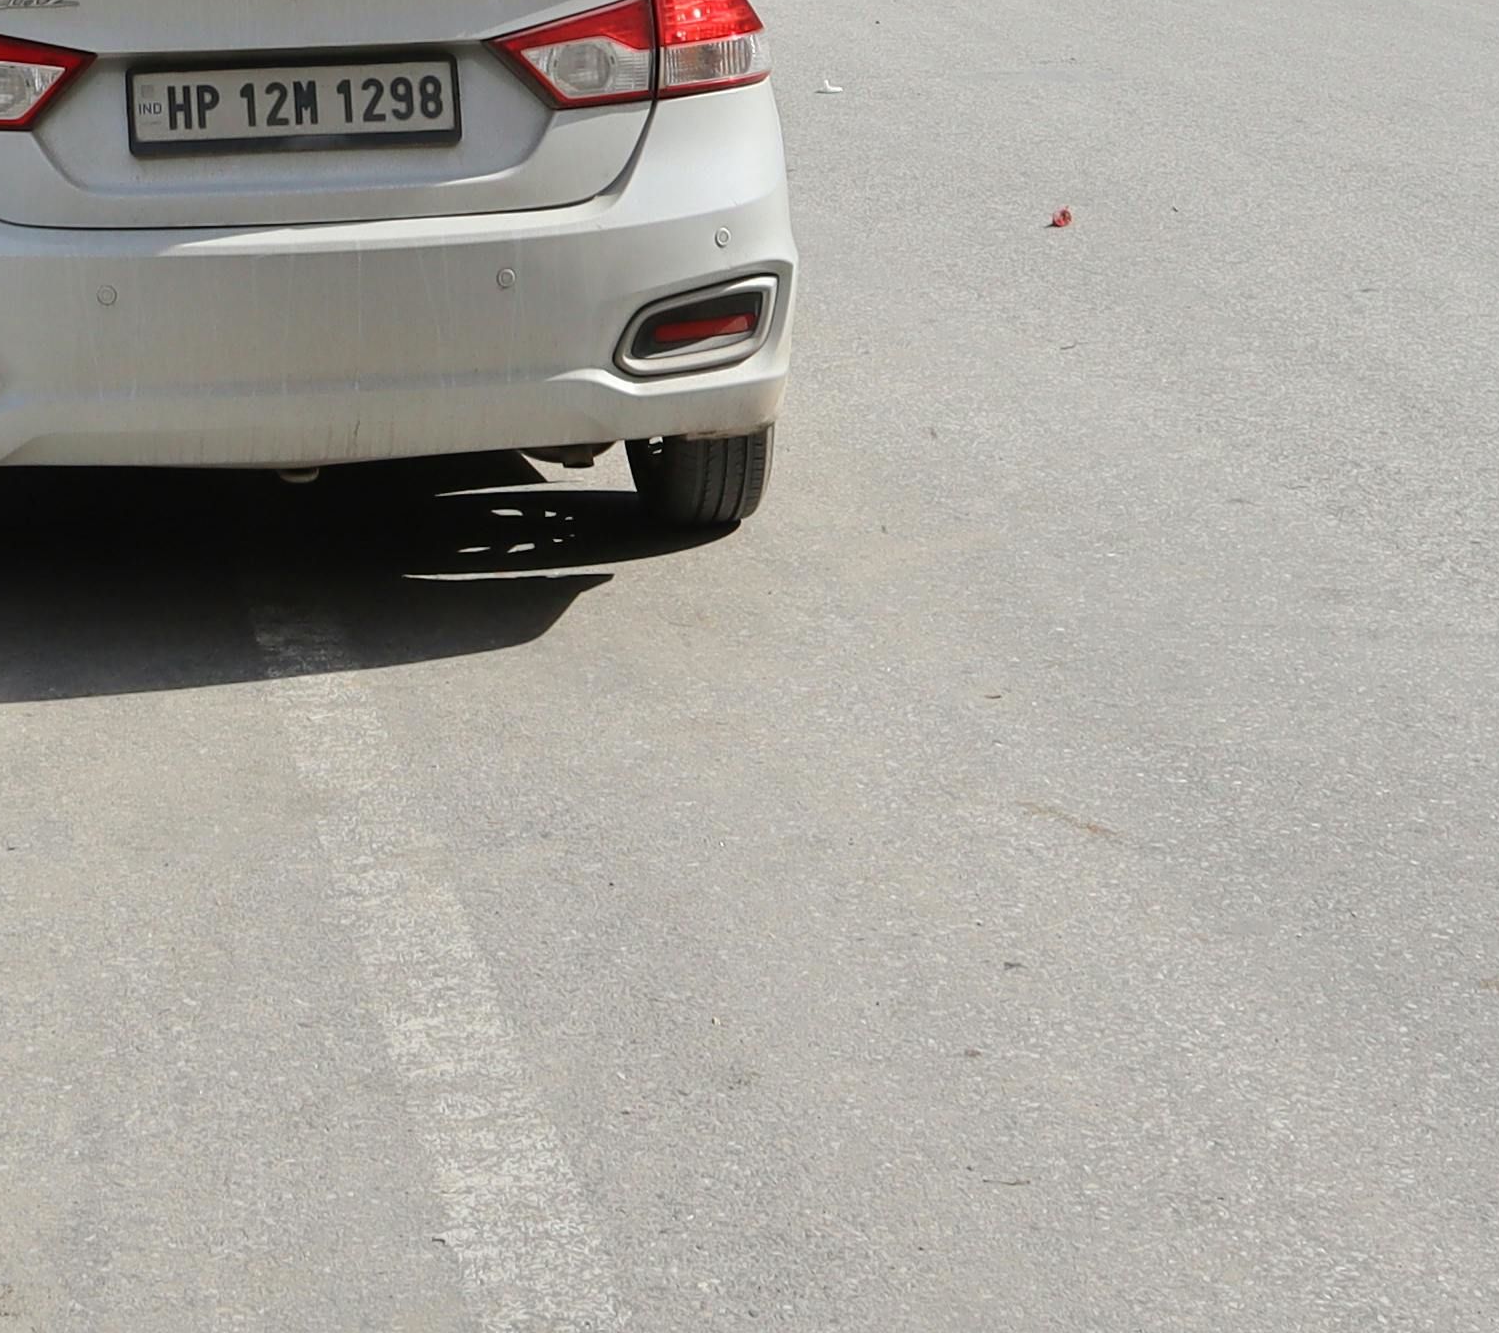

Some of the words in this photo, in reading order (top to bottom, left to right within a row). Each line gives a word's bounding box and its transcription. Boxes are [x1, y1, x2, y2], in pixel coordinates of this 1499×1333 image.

[138, 102, 162, 114] IND
[167, 84, 220, 130] HP
[239, 81, 319, 127] 12M
[336, 75, 444, 123] 1298
